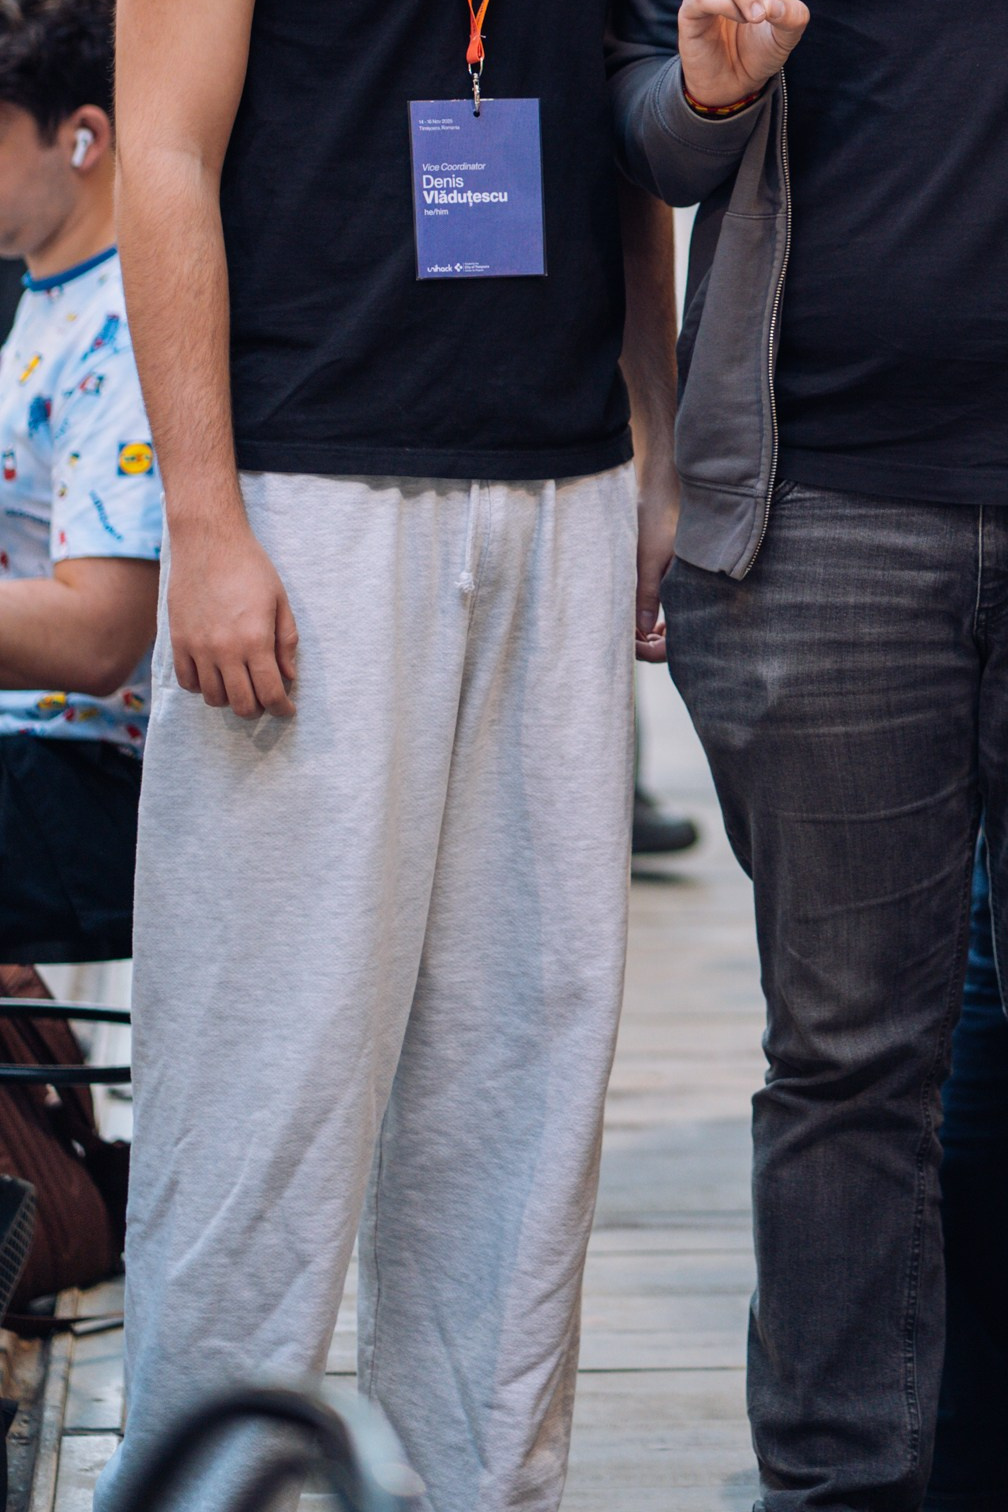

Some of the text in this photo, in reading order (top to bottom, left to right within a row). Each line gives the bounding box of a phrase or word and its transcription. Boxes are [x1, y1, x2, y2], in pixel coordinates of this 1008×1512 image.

[422, 162, 486, 172] Vice Coordinator
[422, 175, 464, 189] Denis
[423, 190, 508, 207] Vlăduțescu
[424, 208, 449, 216] he/him
[427, 263, 453, 273] unihack
